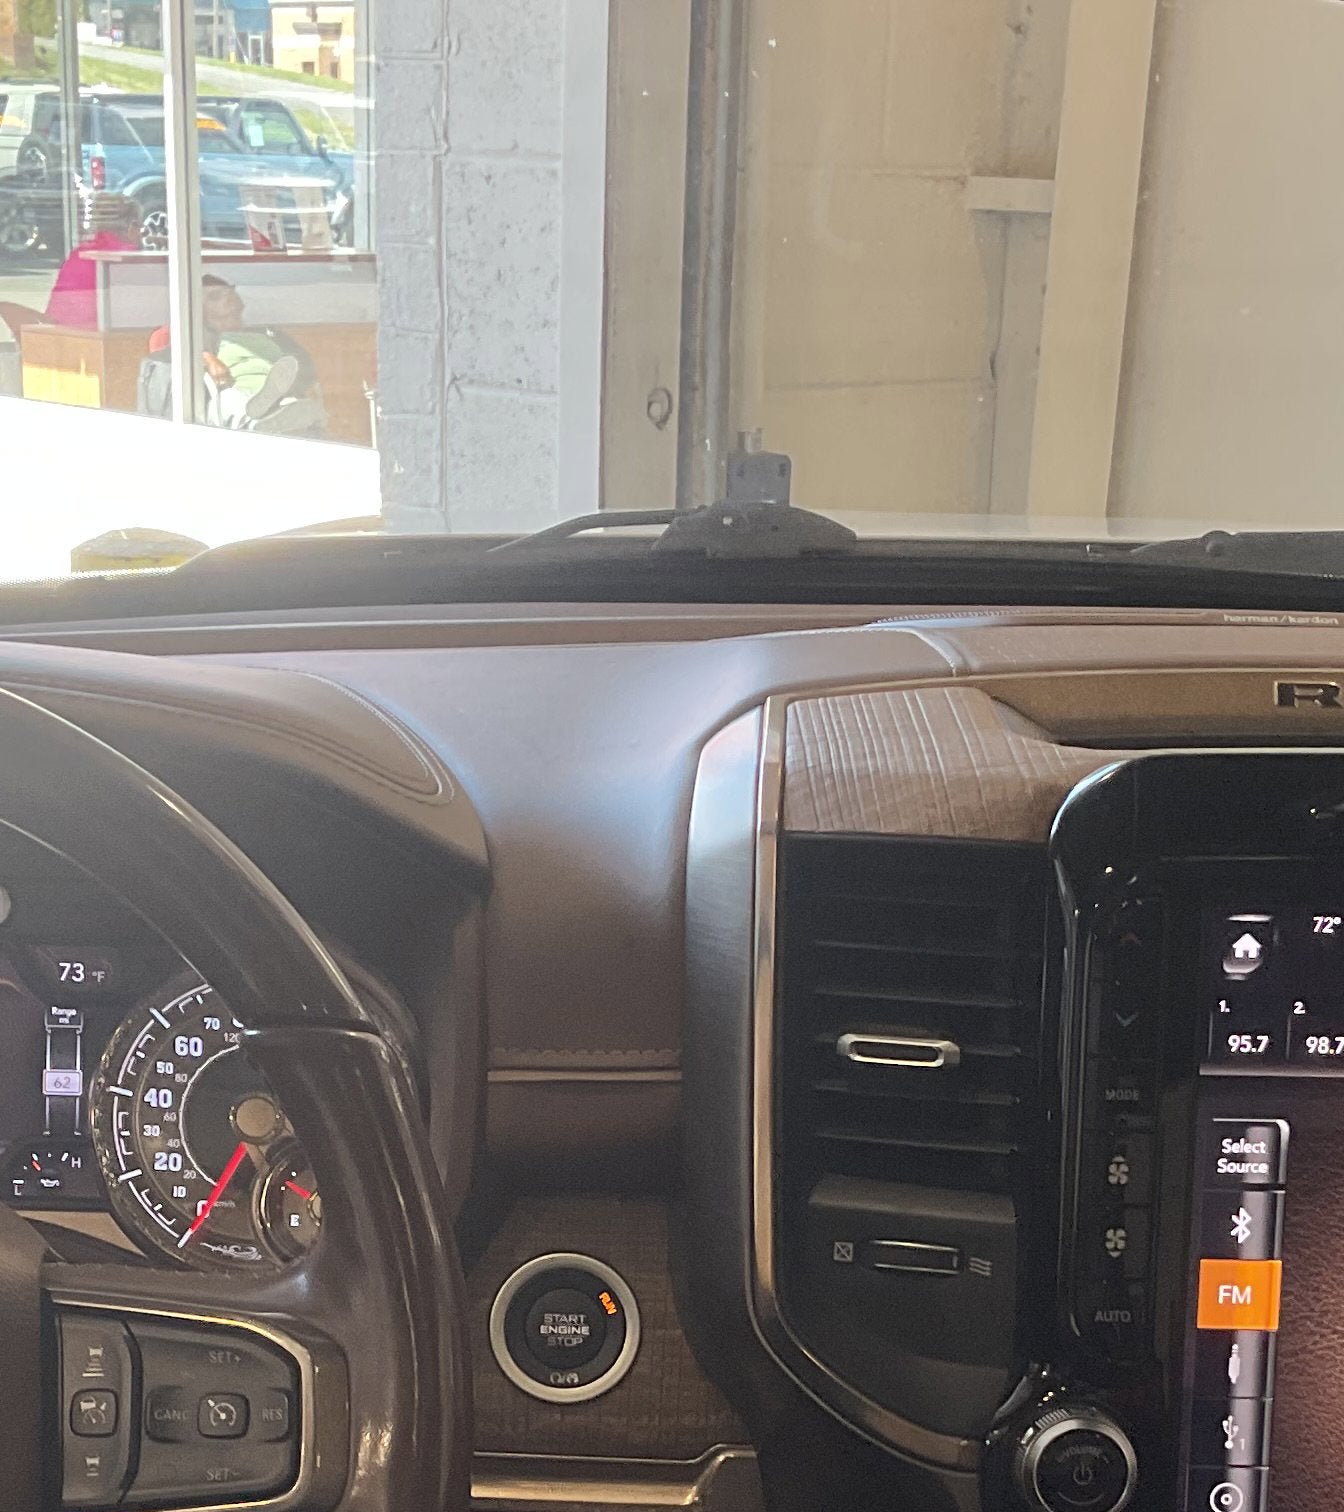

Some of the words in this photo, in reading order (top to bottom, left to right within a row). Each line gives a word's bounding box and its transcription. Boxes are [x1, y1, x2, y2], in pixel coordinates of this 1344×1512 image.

[59, 962, 85, 982] 73
[51, 1006, 77, 1018] Range
[204, 1017, 221, 1031] 70
[175, 1035, 204, 1057] 60
[1227, 1034, 1269, 1053] 95.7
[156, 1061, 174, 1074] 50
[53, 1077, 71, 1088] 62
[144, 1088, 173, 1108] 40
[143, 1124, 161, 1137] 30
[1221, 1138, 1267, 1154] Select
[153, 1152, 183, 1172] 20
[1216, 1158, 1269, 1174] Source
[172, 1185, 187, 1198] 10
[1217, 1285, 1252, 1305] FM
[543, 1313, 586, 1324] START
[539, 1324, 590, 1335] ENGINE
[546, 1336, 584, 1347] STOP
